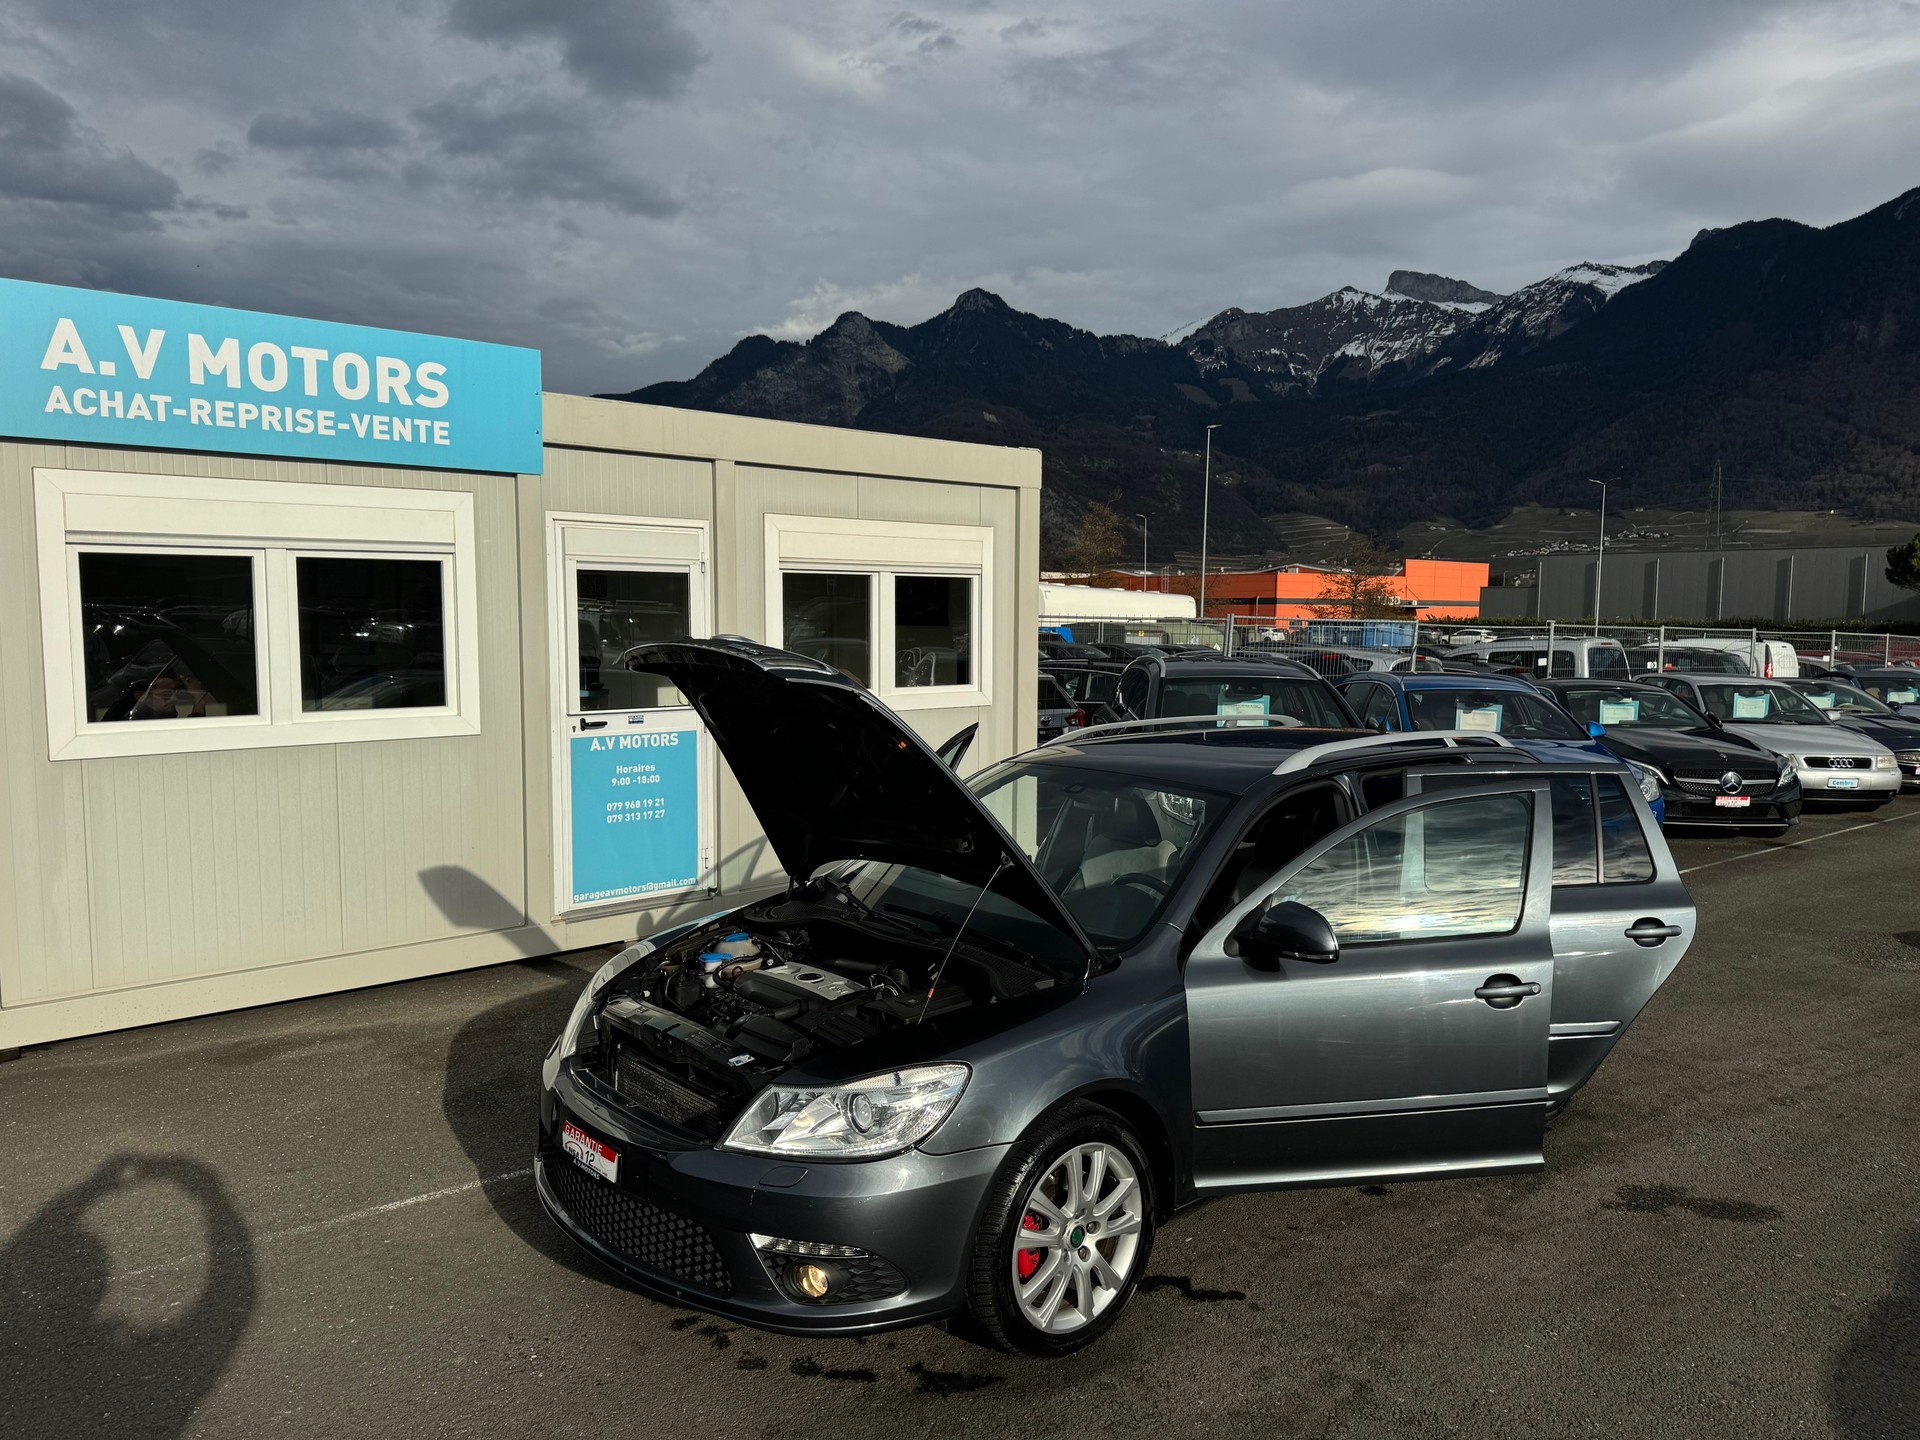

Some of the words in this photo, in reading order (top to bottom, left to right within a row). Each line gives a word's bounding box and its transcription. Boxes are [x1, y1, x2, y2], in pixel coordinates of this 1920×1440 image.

[40, 317, 166, 380] A.V
[188, 333, 450, 409] MOTORS
[44, 384, 451, 446] ACHAT-REPRISE-VENTE
[590, 736, 616, 751] A.V
[619, 733, 679, 750] MOTORS
[616, 763, 656, 775] Horaires
[611, 777, 631, 787] 9:00
[606, 802, 623, 812] 079
[624, 800, 641, 809] 968
[642, 799, 653, 808] 19
[654, 798, 665, 807] 21
[606, 814, 623, 824] 079
[624, 812, 641, 821] 313
[642, 811, 653, 820] 17
[654, 810, 666, 819] 27
[573, 877, 696, 903] garageavmotors@gmail.com
[564, 1124, 603, 1156] GARANTIE
[585, 1150, 595, 1168] 12
